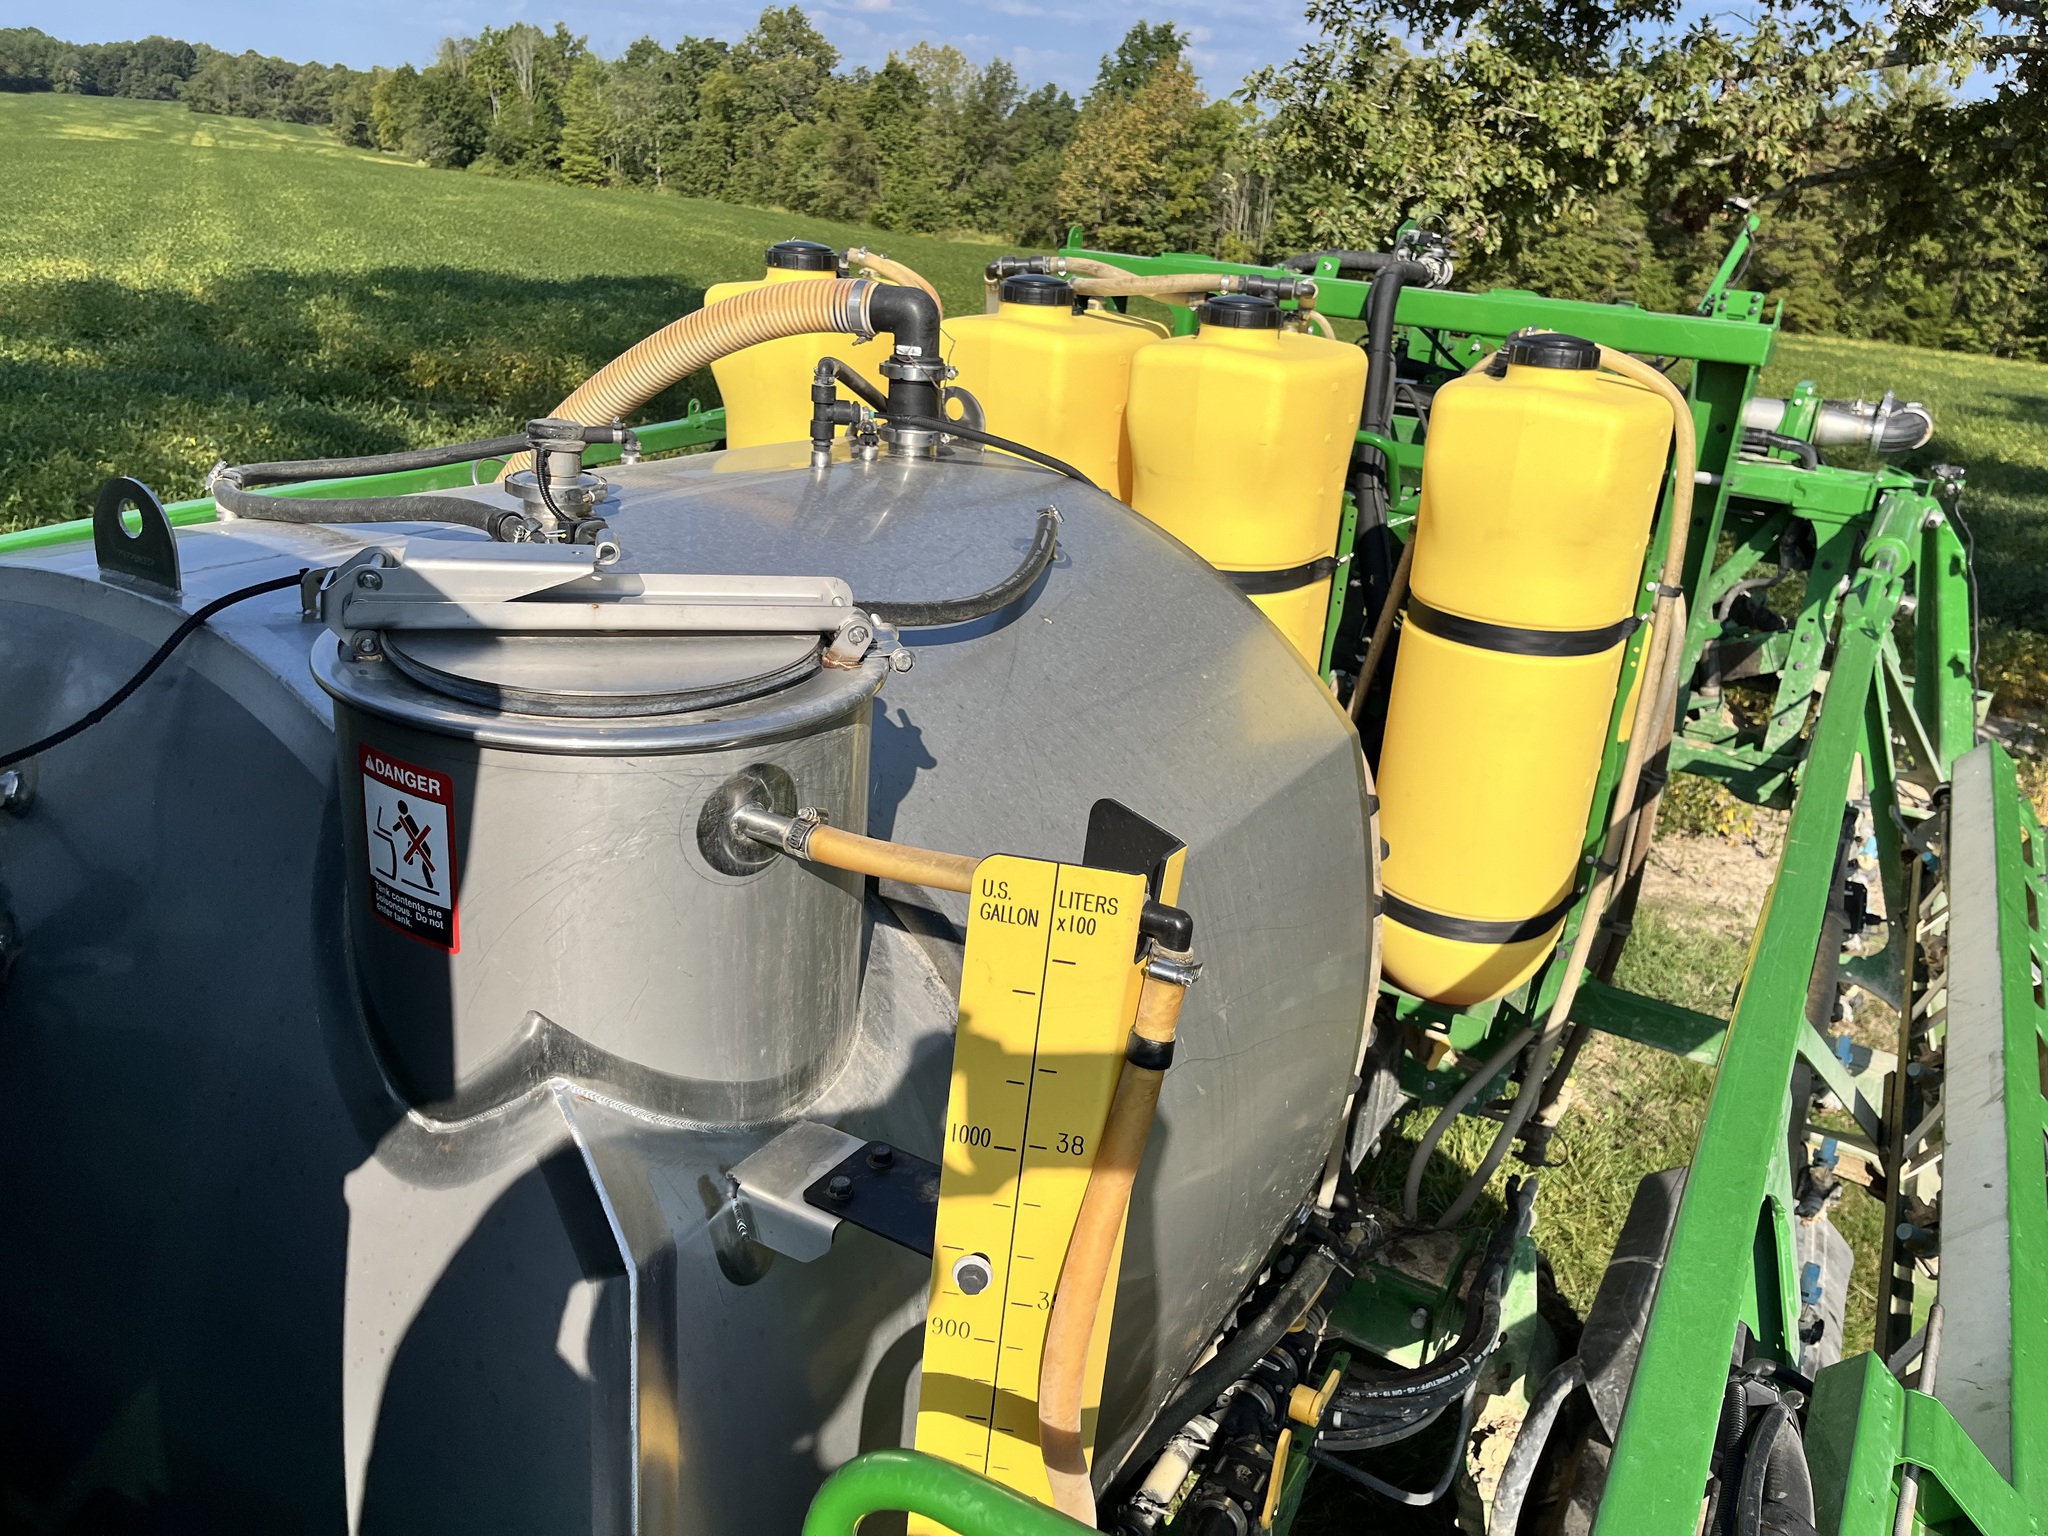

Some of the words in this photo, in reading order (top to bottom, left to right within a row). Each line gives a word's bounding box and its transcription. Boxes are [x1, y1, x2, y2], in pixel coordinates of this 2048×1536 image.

[375, 758, 441, 797] DANGER
[374, 880, 391, 897] Tank
[391, 893, 426, 913] contents
[427, 908, 442, 919] are
[982, 879, 1012, 901] U.S.
[375, 893, 413, 918] poisonous.
[415, 912, 427, 923] Do
[429, 919, 444, 930] not
[376, 902, 393, 918] enter
[980, 902, 1040, 928] GALLON
[1058, 890, 1119, 916] LITERS
[1056, 917, 1097, 936] x100
[951, 1123, 992, 1148] 1000
[1056, 1132, 1085, 1156] 38
[1037, 1290, 1057, 1311] 3
[931, 1316, 971, 1340] 900
